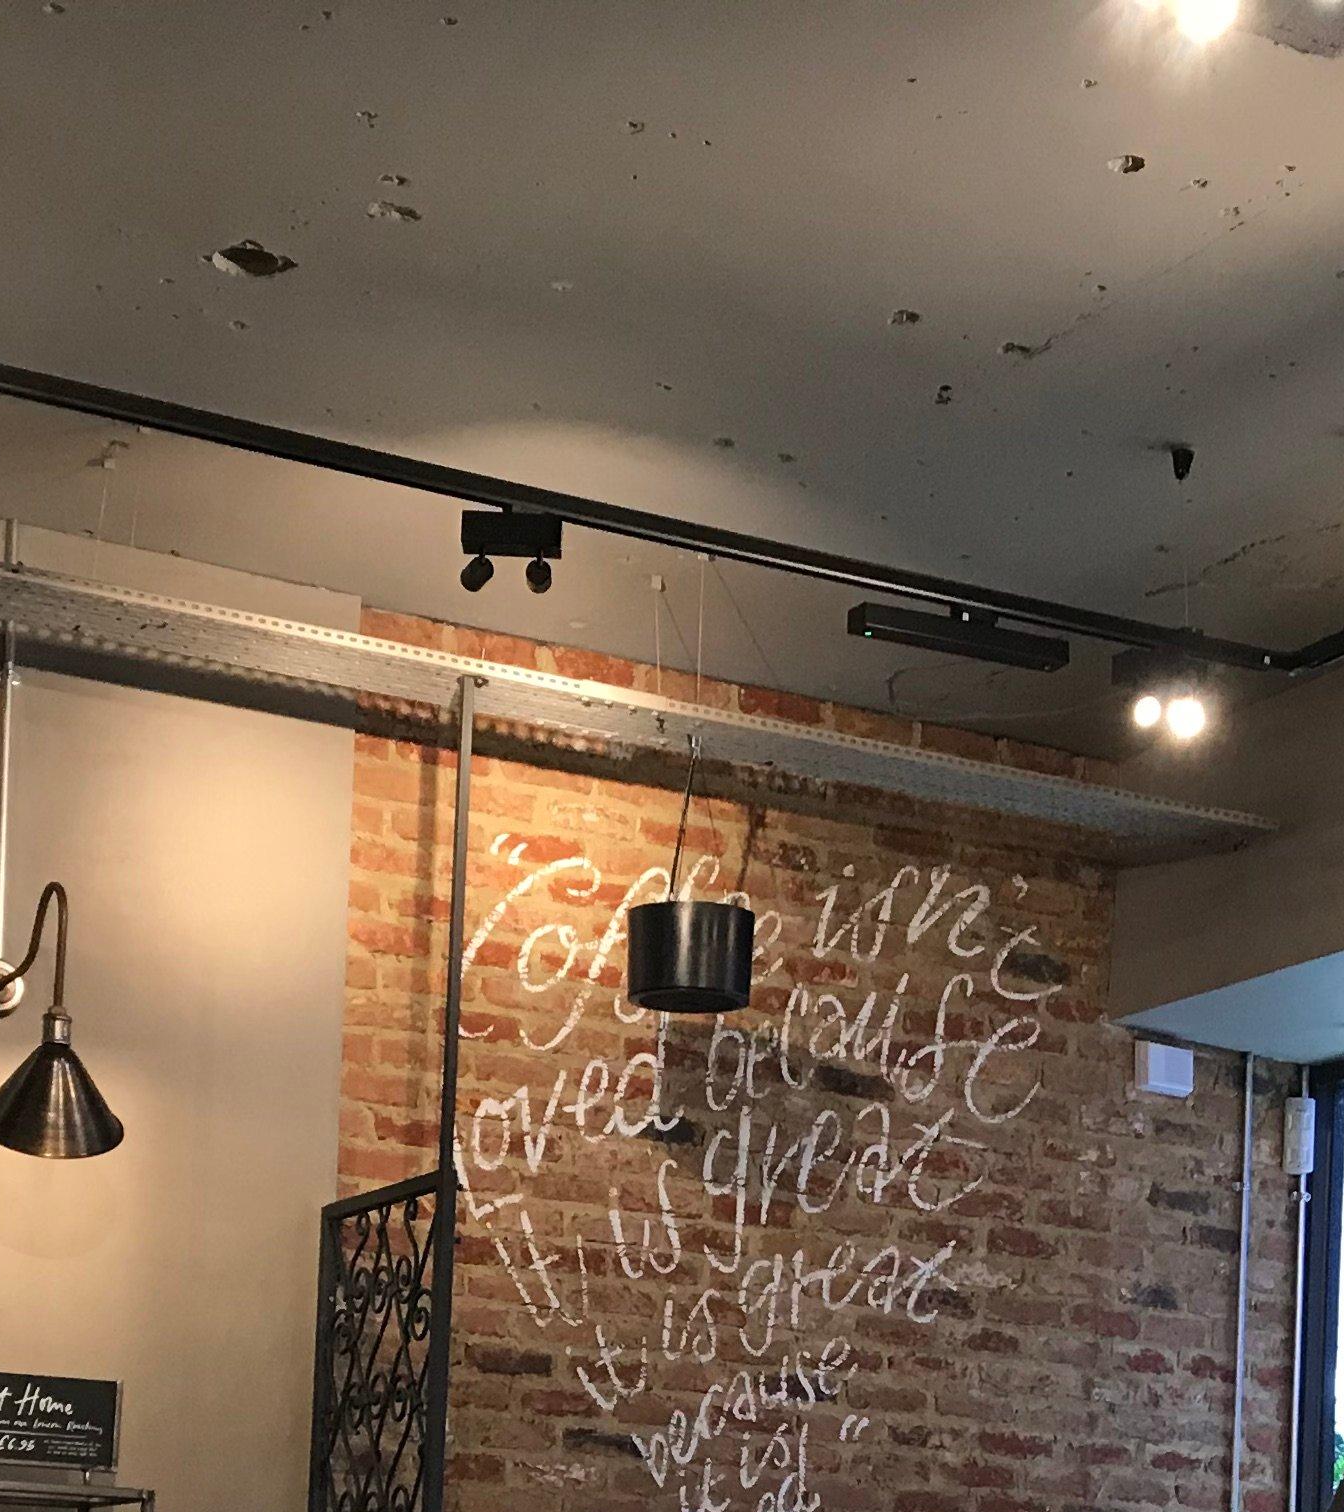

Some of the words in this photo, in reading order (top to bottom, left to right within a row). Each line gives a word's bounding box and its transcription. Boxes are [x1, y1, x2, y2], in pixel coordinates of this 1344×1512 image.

[608, 1157, 683, 1280] is
[702, 1102, 988, 1274] great
[662, 1287, 720, 1364] is
[739, 1239, 958, 1356] great
[14, 1382, 74, 1416] Home
[630, 1335, 857, 1488] because
[740, 1421, 792, 1490] is
